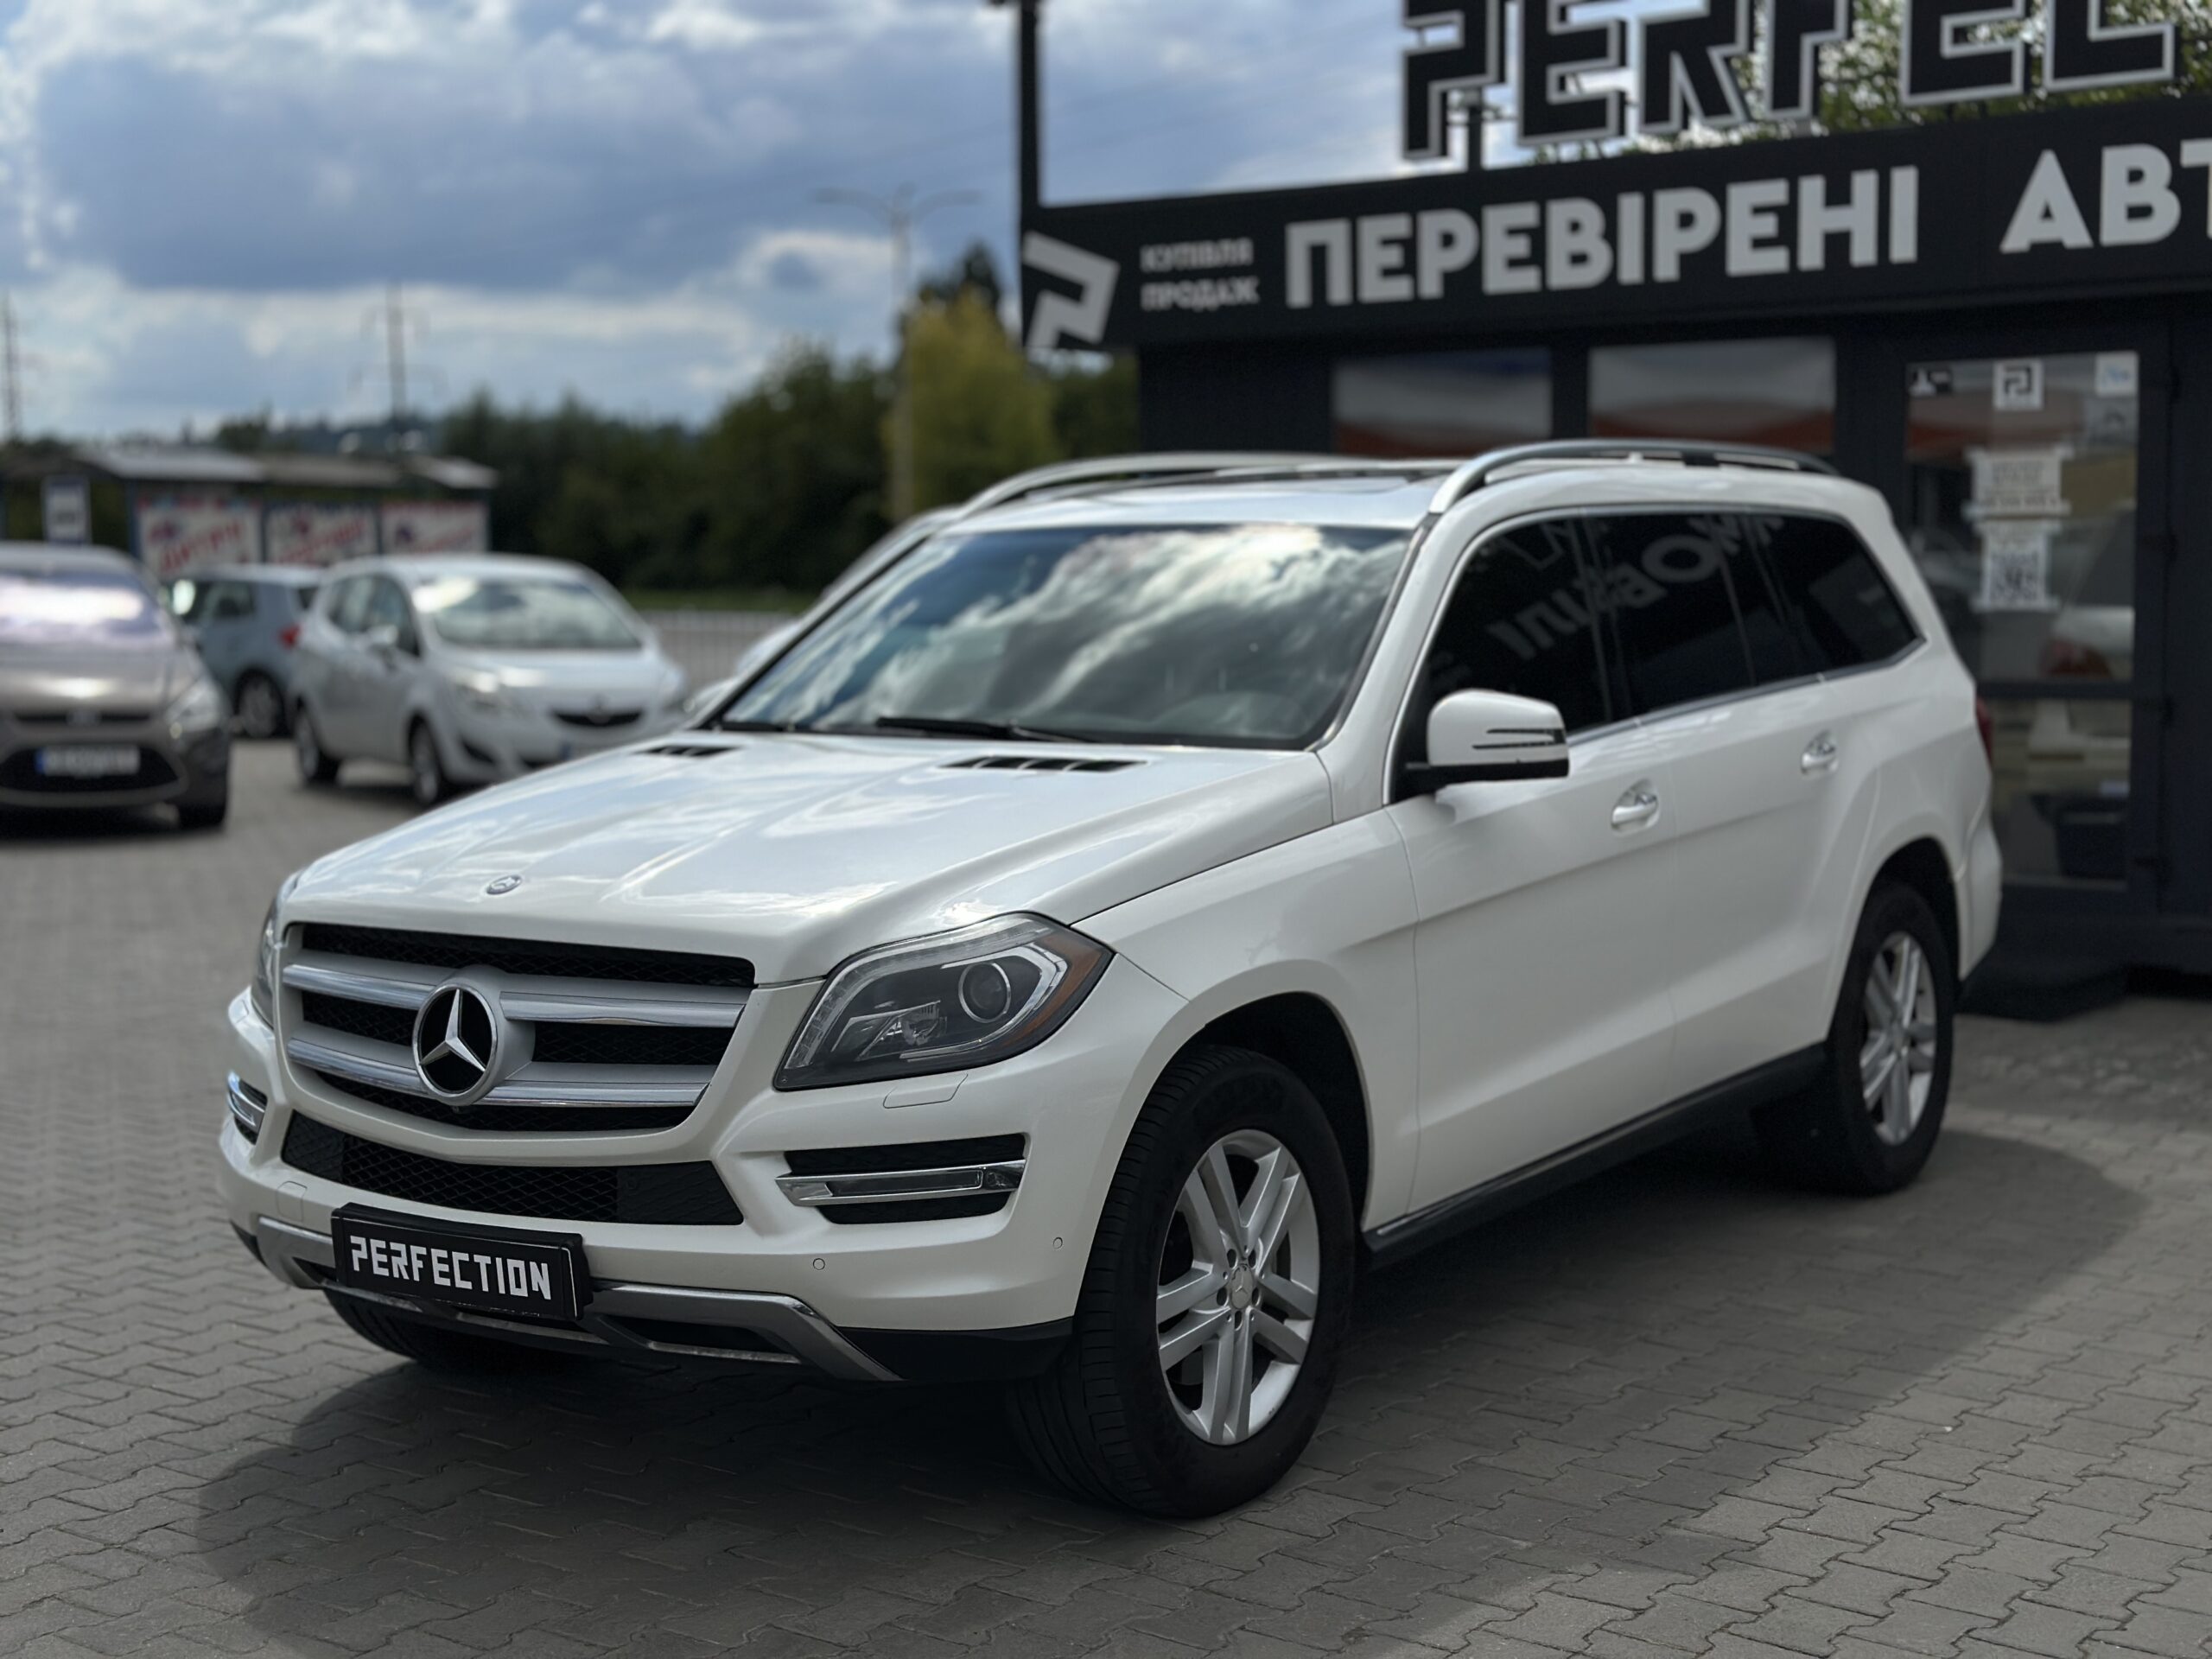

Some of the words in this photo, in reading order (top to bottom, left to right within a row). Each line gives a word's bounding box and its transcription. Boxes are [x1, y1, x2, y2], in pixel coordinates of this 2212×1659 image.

[1285, 164, 1919, 309] ПЕРЕВІРЕНІ
[1140, 276, 1261, 313] ПРОДАЖ
[350, 1234, 552, 1301] PERFECTION
